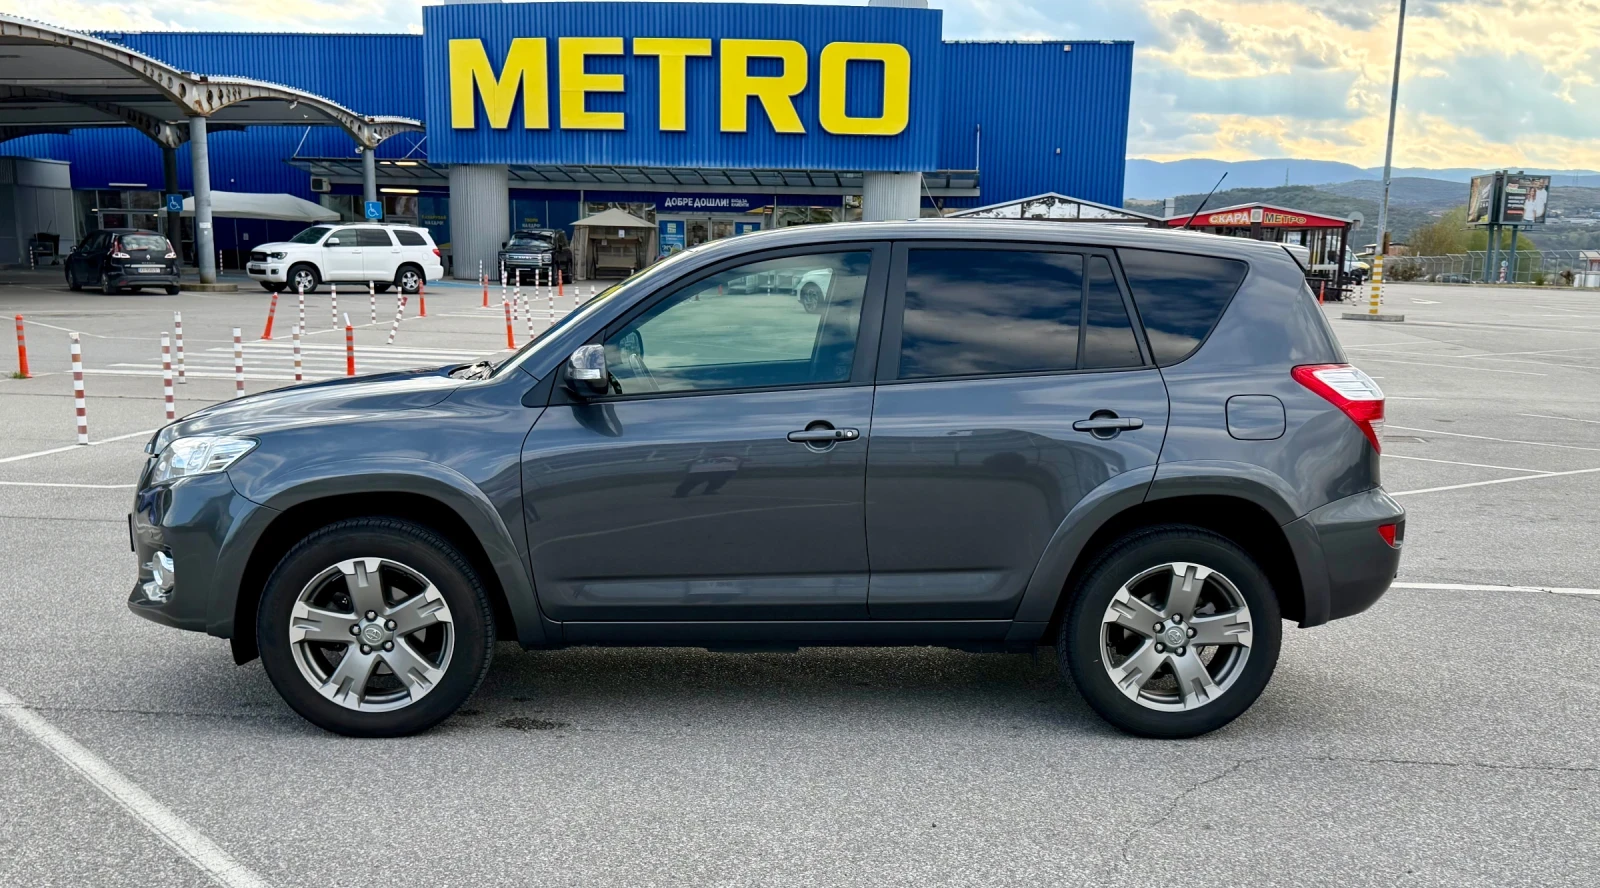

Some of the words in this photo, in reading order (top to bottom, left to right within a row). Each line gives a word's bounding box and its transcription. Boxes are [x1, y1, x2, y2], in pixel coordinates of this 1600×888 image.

[448, 37, 911, 136] METRO
[665, 198, 693, 207] ДОБРЕ
[694, 198, 729, 207] ДОШЛИ!
[1209, 212, 1251, 224] СКАРА
[1264, 212, 1306, 224] МЕТРО
